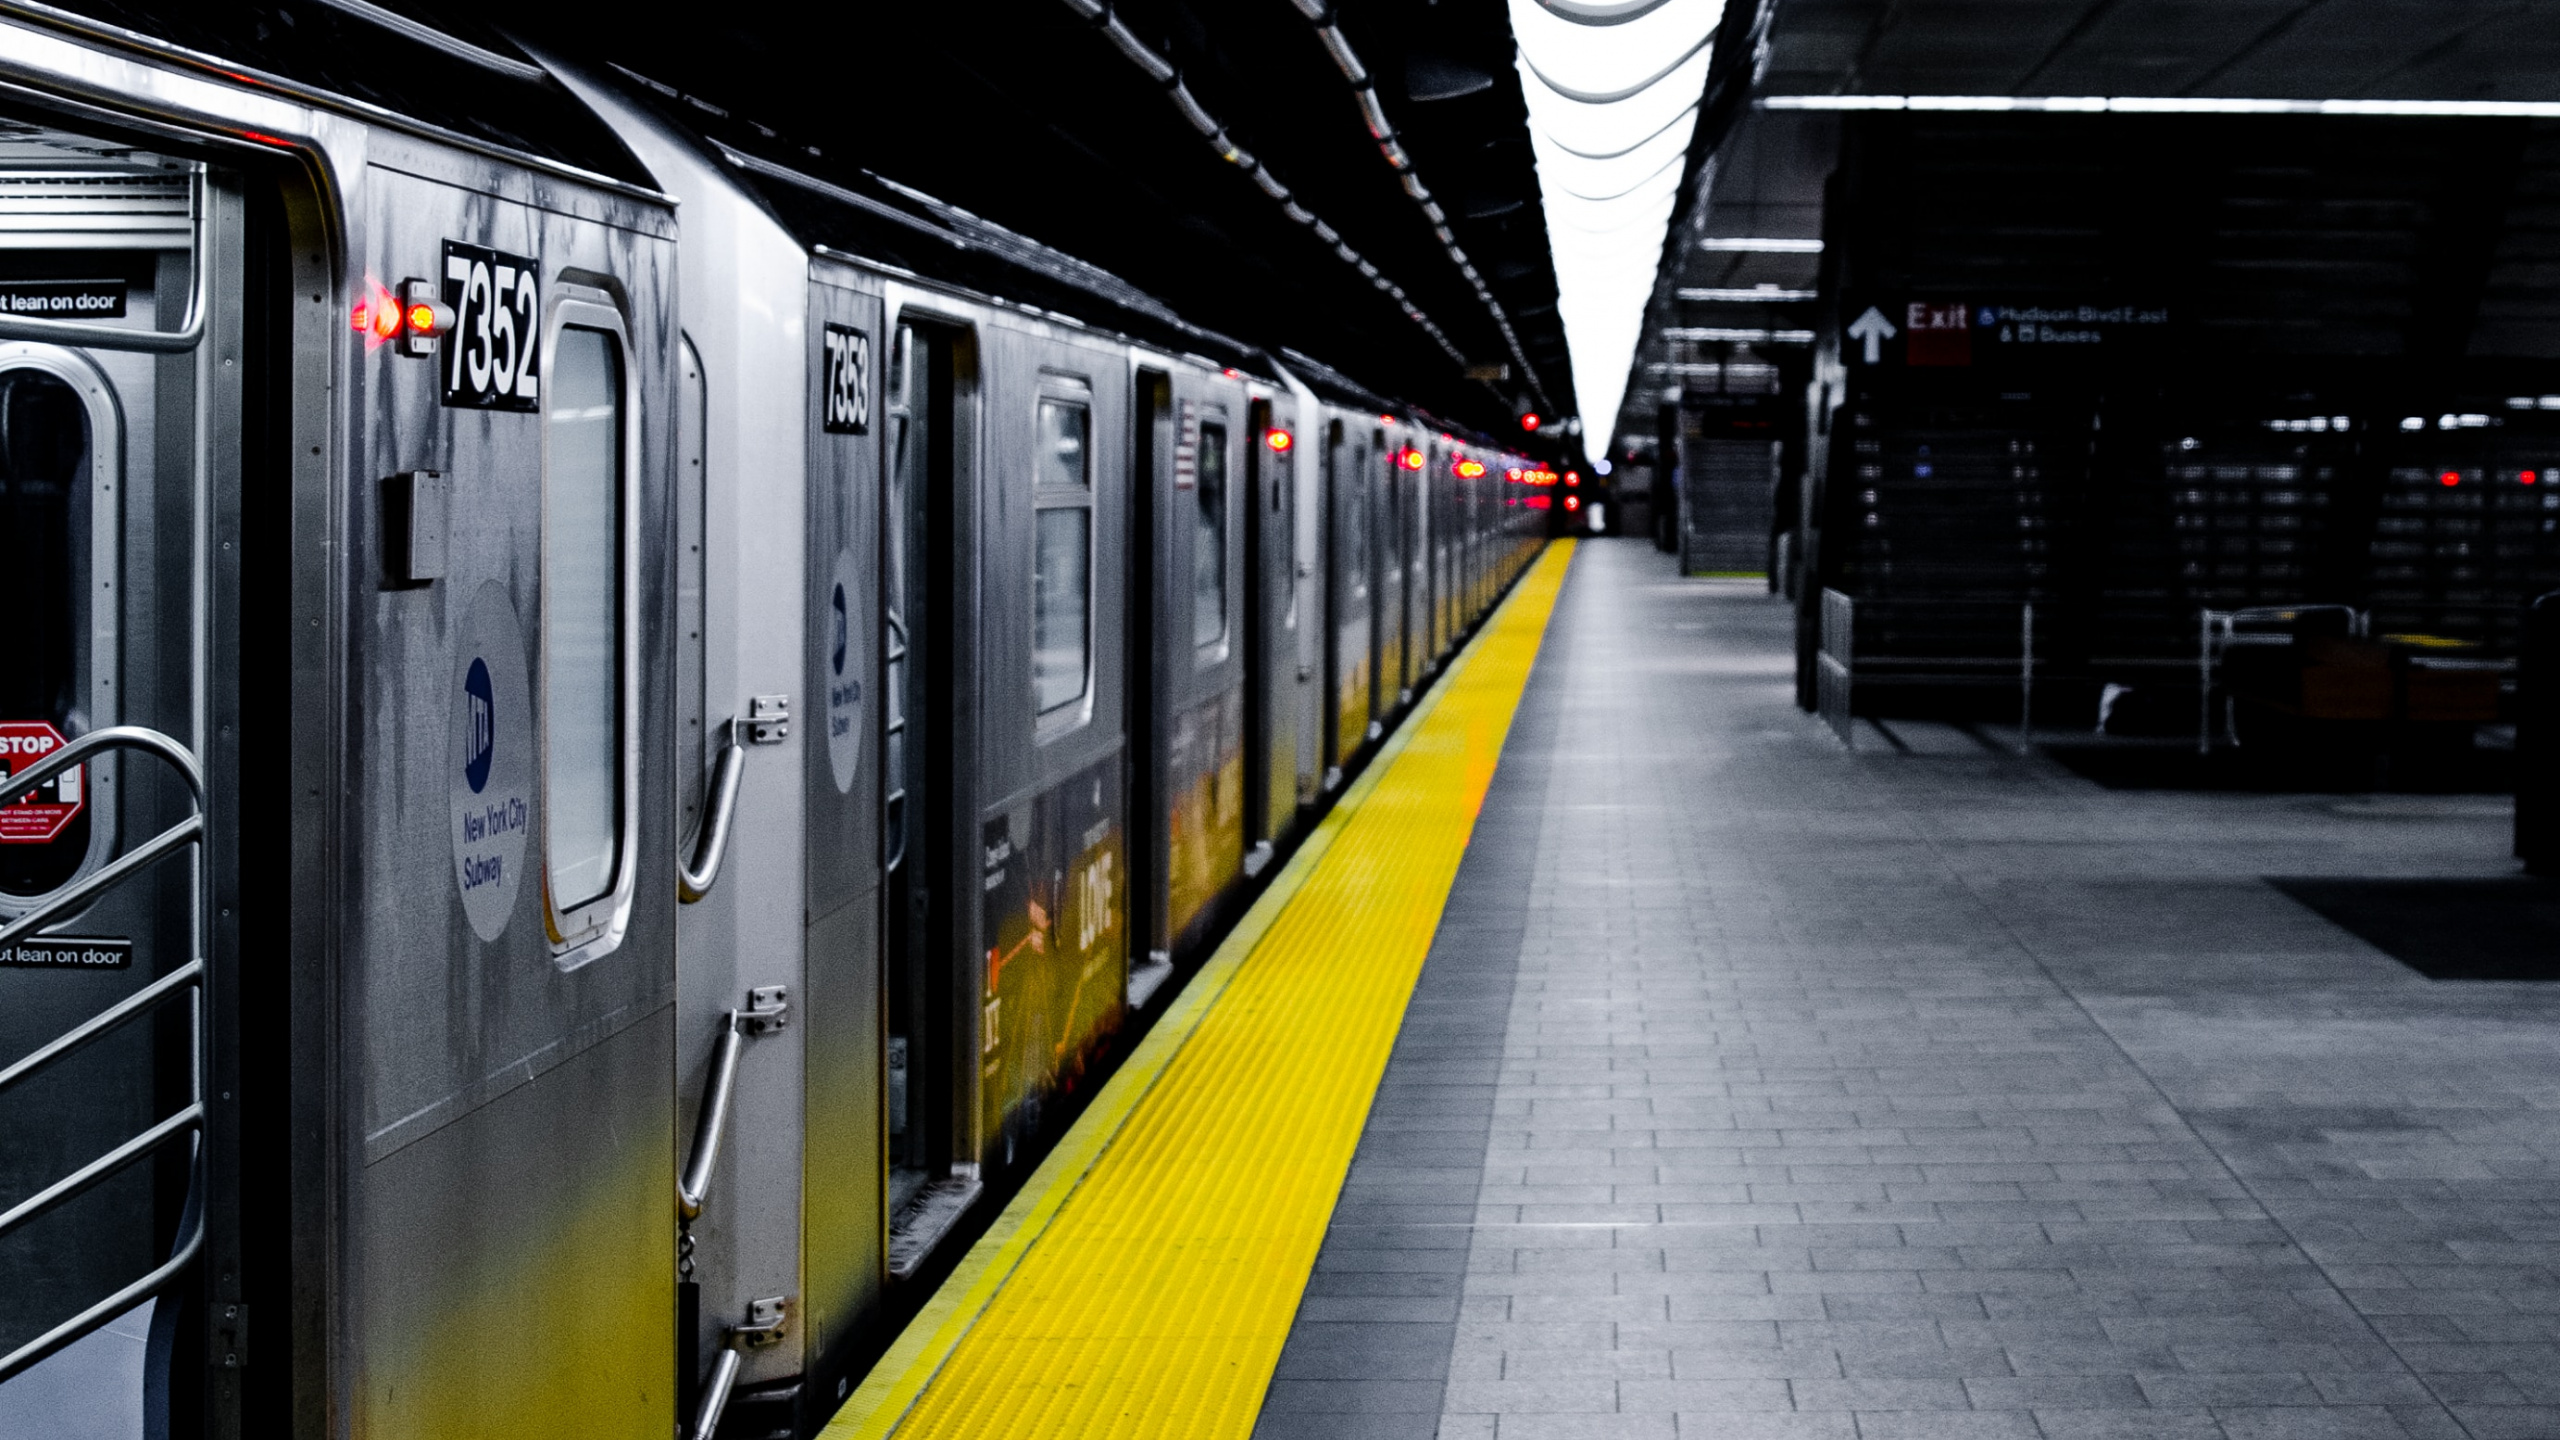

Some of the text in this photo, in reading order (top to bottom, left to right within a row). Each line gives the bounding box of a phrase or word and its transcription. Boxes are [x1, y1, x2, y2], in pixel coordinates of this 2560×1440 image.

[11, 294, 48, 311] lean
[50, 296, 73, 310] on
[75, 293, 116, 309] door
[1907, 303, 1967, 329] Exit
[447, 255, 538, 398] 7352
[826, 330, 869, 425] 7353
[0, 736, 54, 754] STOP
[464, 797, 527, 844] New York City
[464, 853, 502, 891] Subway
[16, 946, 52, 962] lean
[56, 950, 78, 963] on
[82, 948, 123, 964] door
